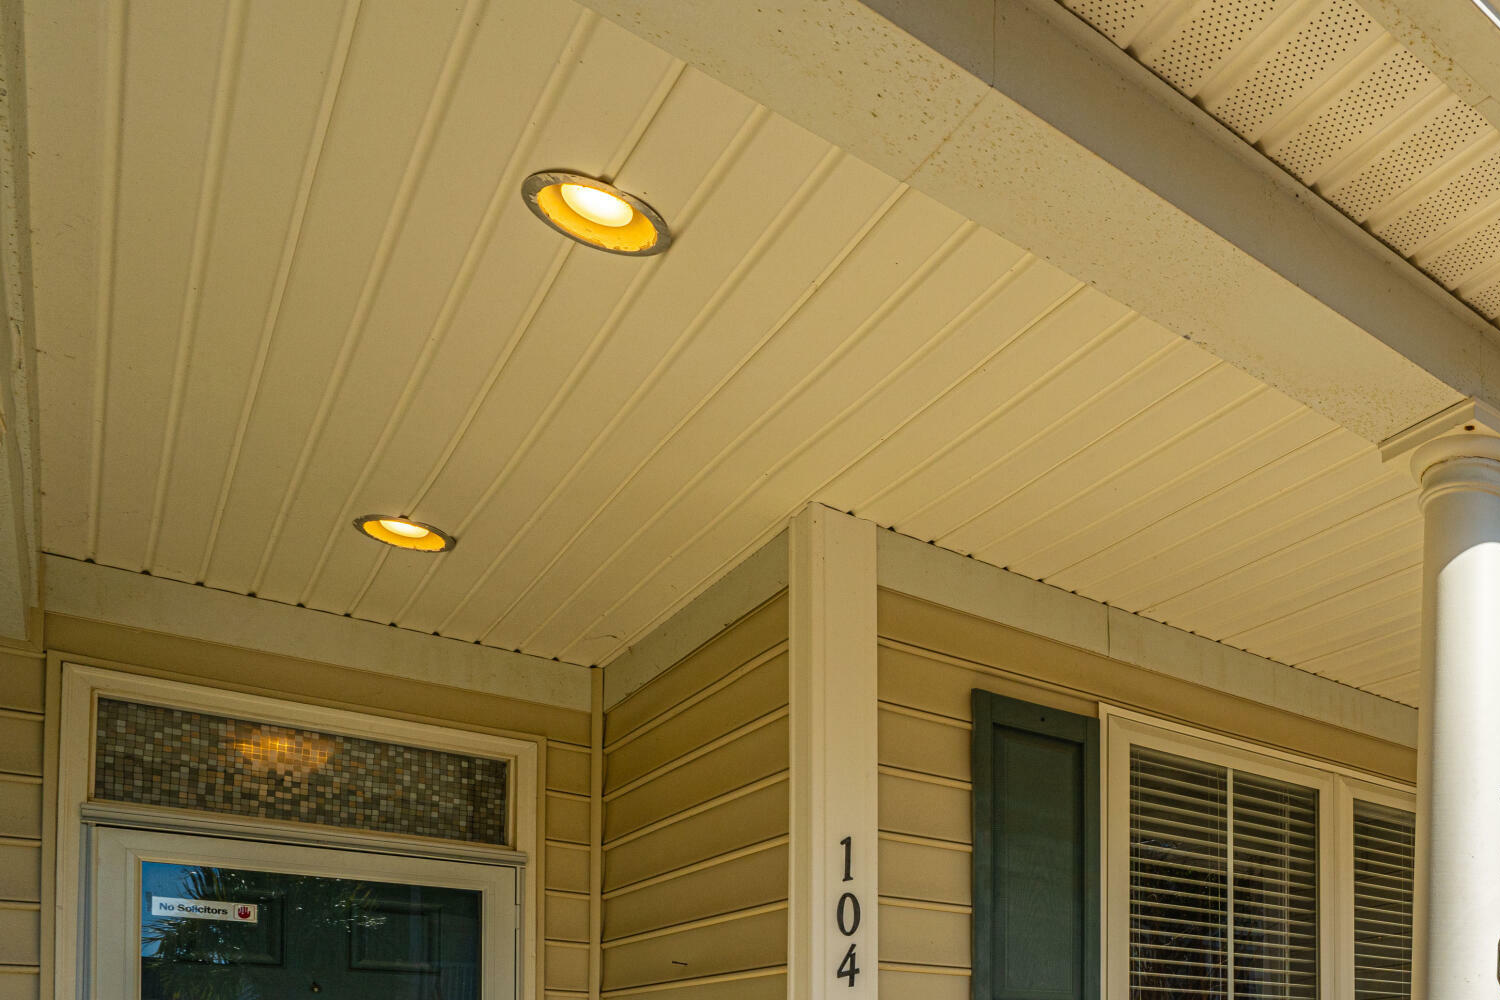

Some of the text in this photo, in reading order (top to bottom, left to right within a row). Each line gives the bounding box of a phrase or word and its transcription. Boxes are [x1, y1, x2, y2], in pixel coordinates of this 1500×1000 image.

[159, 902, 228, 915] No Solicitors
[836, 836, 861, 988] 104
